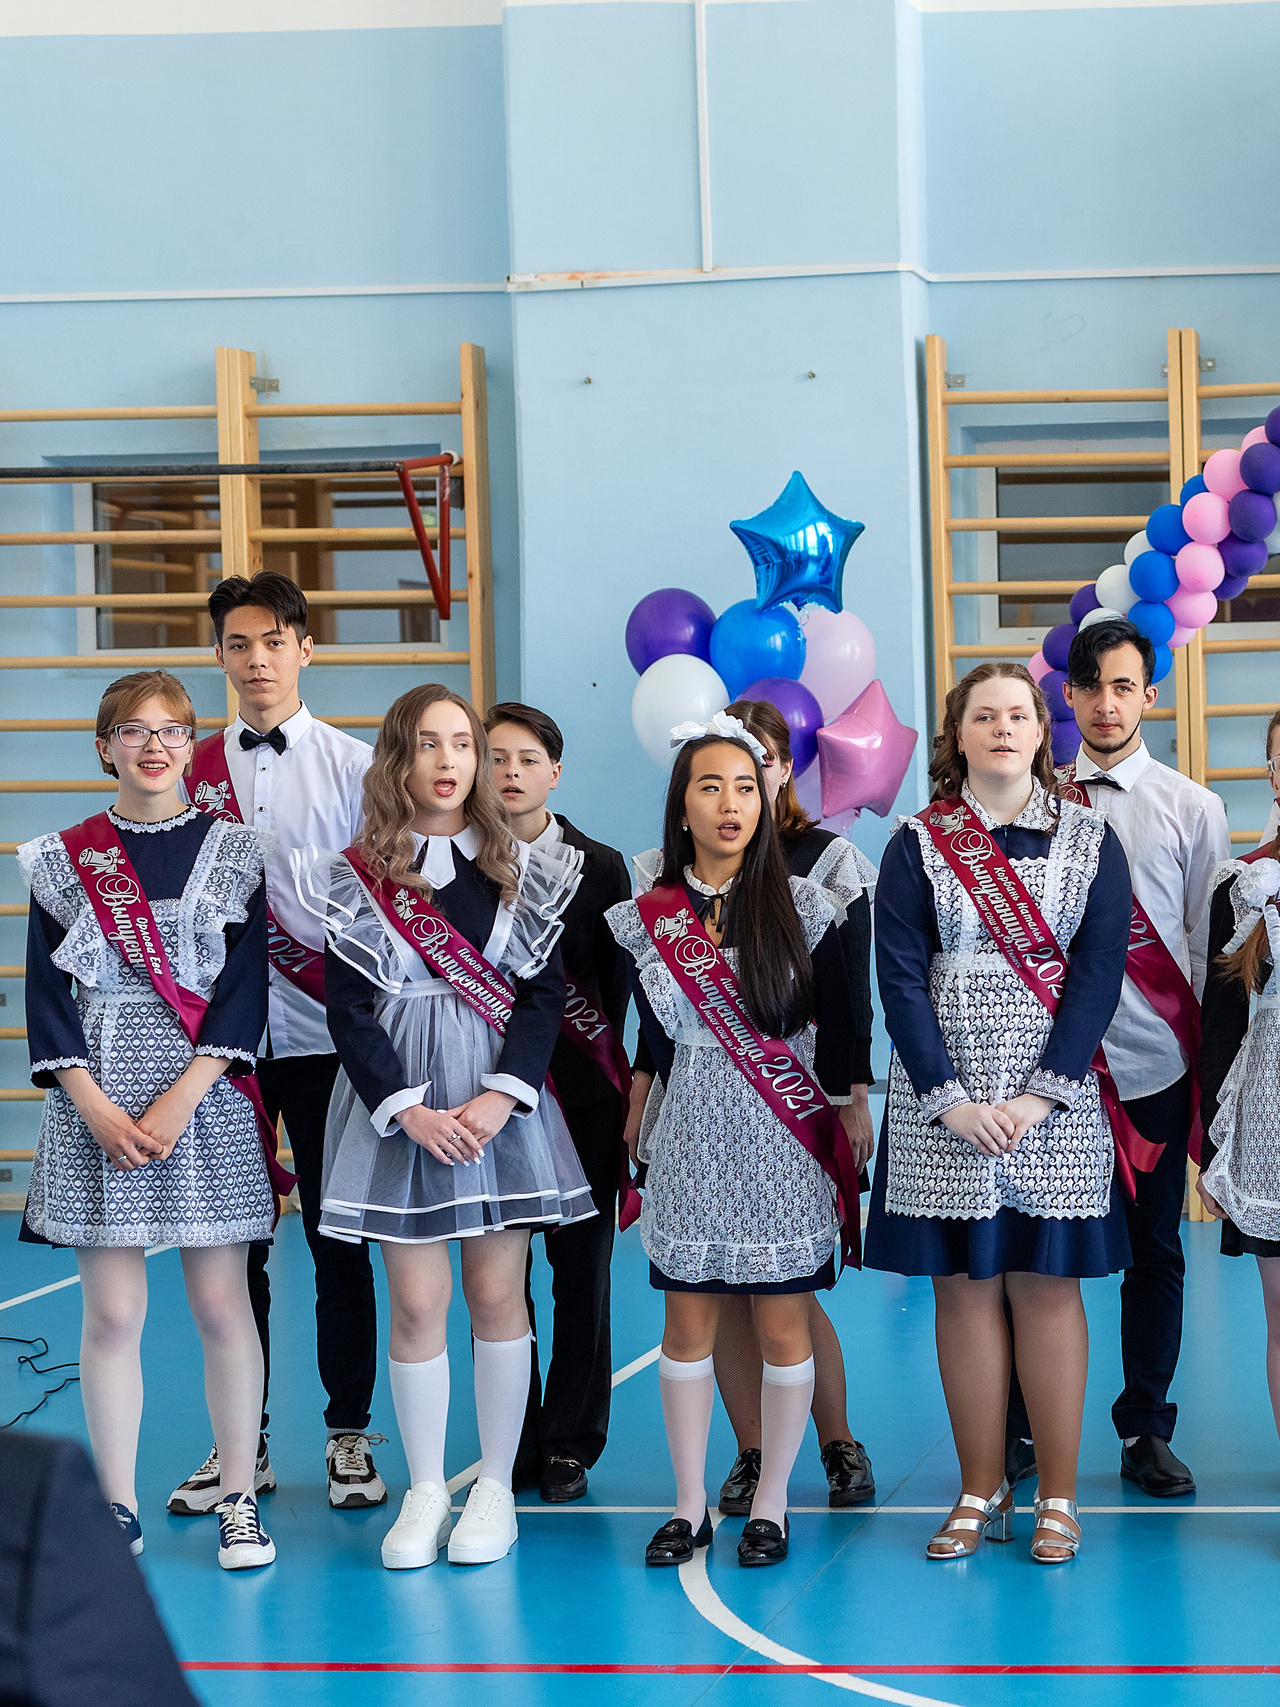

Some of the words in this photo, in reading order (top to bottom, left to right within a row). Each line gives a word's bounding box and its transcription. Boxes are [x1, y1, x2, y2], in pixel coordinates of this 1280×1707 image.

[96, 872, 154, 989] Выпускниц
[950, 828, 1033, 952] Выпускница
[1021, 946, 1065, 999] 202
[975, 893, 990, 912] МБОУ
[984, 911, 997, 927] СОШ
[1003, 944, 1023, 969] 11класс
[993, 866, 1020, 901] Корбань
[1016, 901, 1046, 944] Наталья
[136, 917, 157, 954] Орлова
[149, 956, 163, 976] Ева
[405, 914, 513, 1023] Выпускница
[457, 947, 484, 973] Плют
[481, 968, 516, 1003] Валерия
[719, 976, 739, 998] Лим
[674, 935, 766, 1063] Выпускница
[757, 1056, 824, 1121] 2021
[703, 1009, 719, 1027] МБОУ
[715, 1023, 729, 1040] СОШ
[737, 1056, 758, 1081] 11класс
